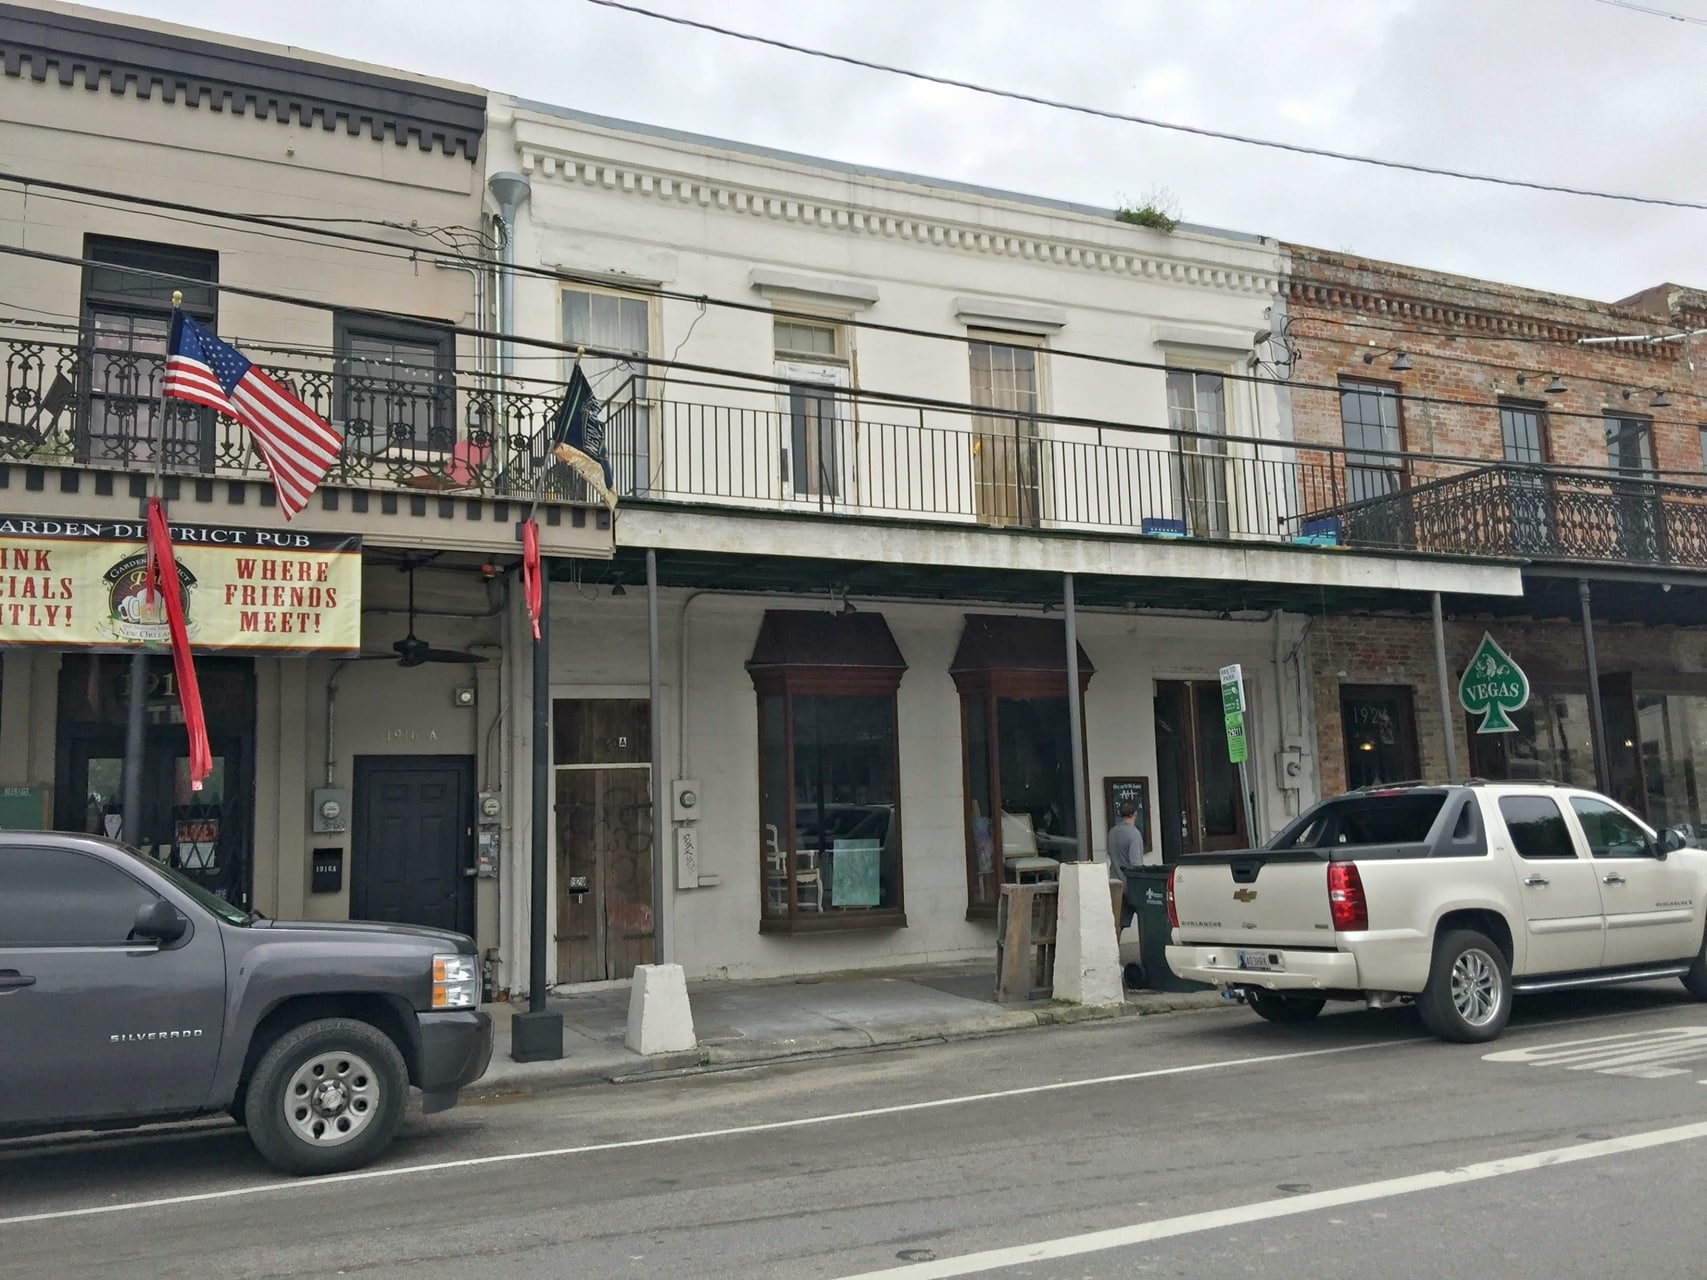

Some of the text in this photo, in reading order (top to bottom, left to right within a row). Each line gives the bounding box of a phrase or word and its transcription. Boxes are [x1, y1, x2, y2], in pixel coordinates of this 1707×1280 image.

[112, 524, 246, 544] DITRICT
[255, 531, 310, 547] PUB
[235, 558, 329, 583] WHERE
[224, 584, 337, 608] FRIENDS
[239, 611, 321, 634] MEET!
[1465, 681, 1520, 702] VEGAS
[109, 1029, 203, 1043] SILVERADO
